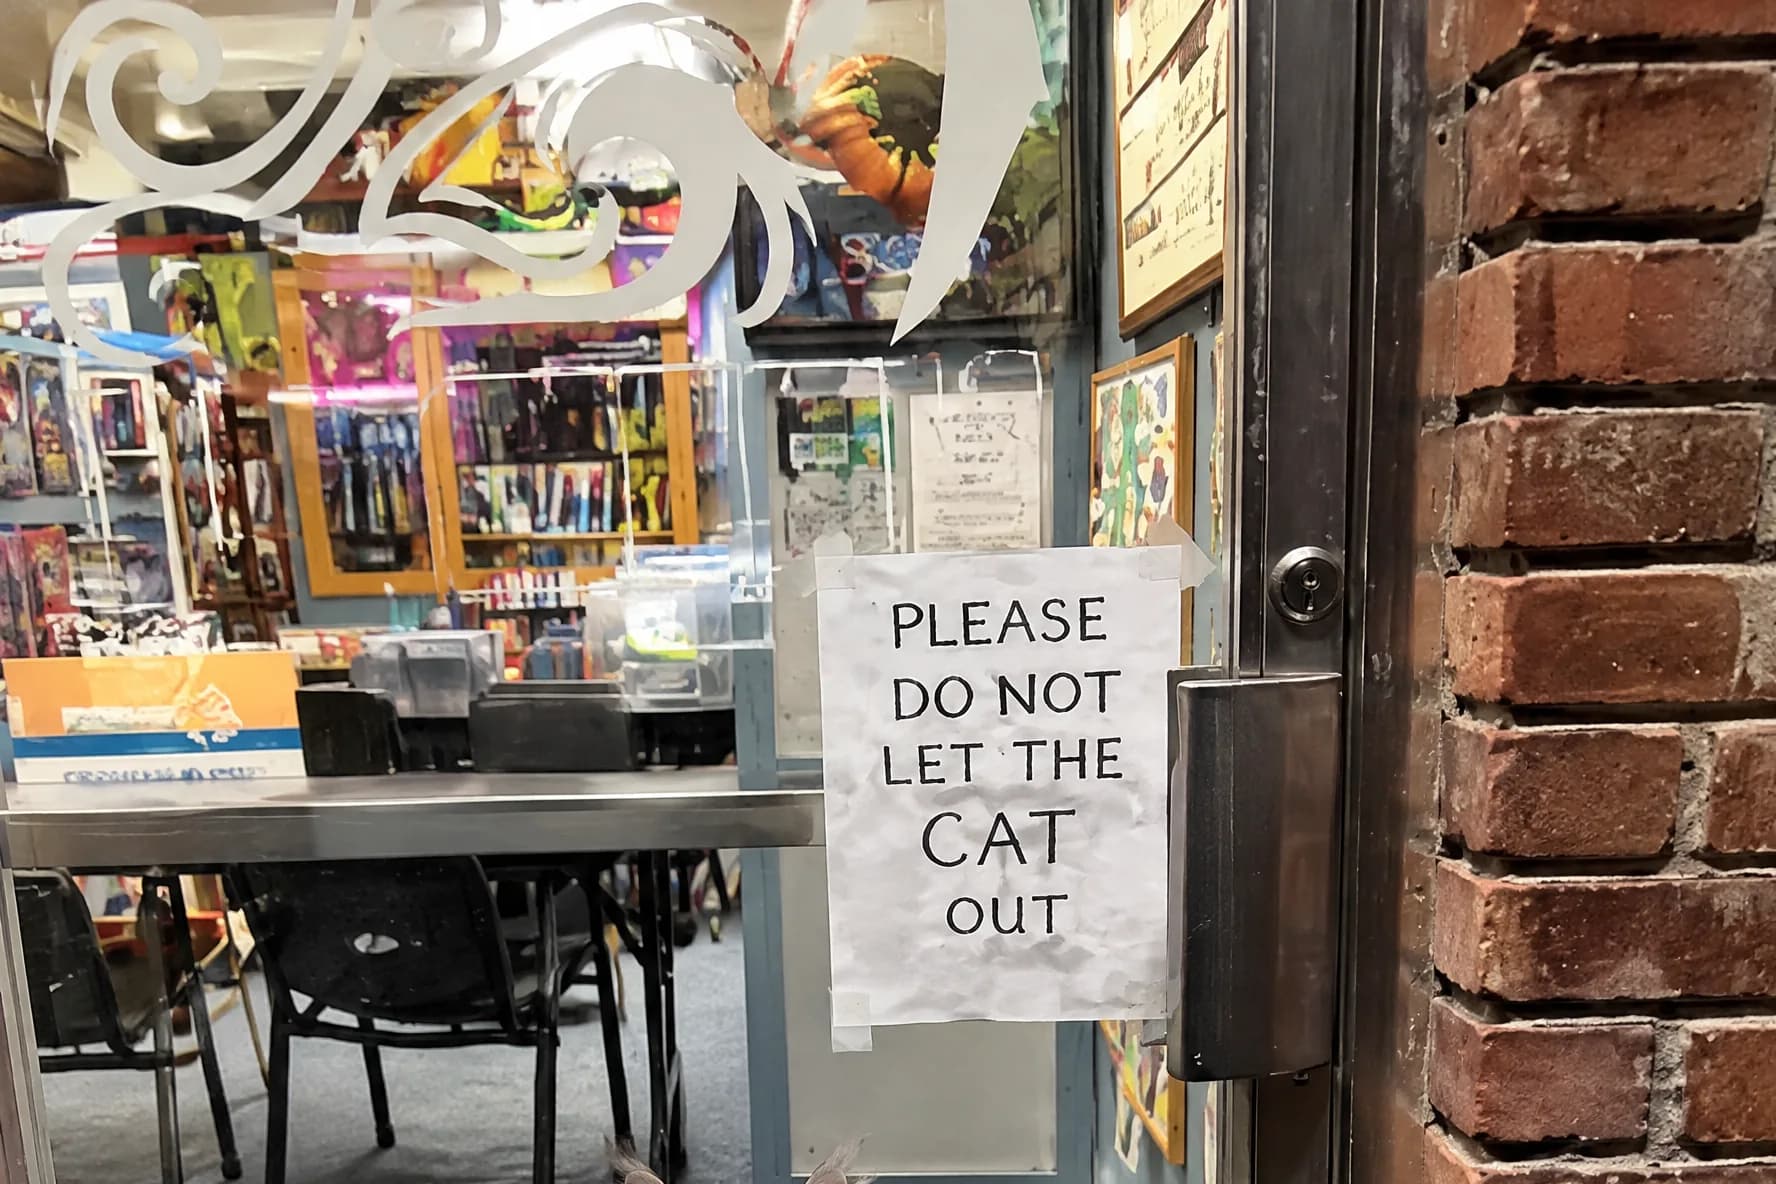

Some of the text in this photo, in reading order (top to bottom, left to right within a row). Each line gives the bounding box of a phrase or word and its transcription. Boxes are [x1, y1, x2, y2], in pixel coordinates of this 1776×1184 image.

[892, 596, 1107, 649] PLEASE
[893, 670, 1122, 721] DO NOT
[883, 737, 1123, 786] LET THE
[922, 809, 1076, 868] CAT
[946, 894, 1068, 935] OUT
